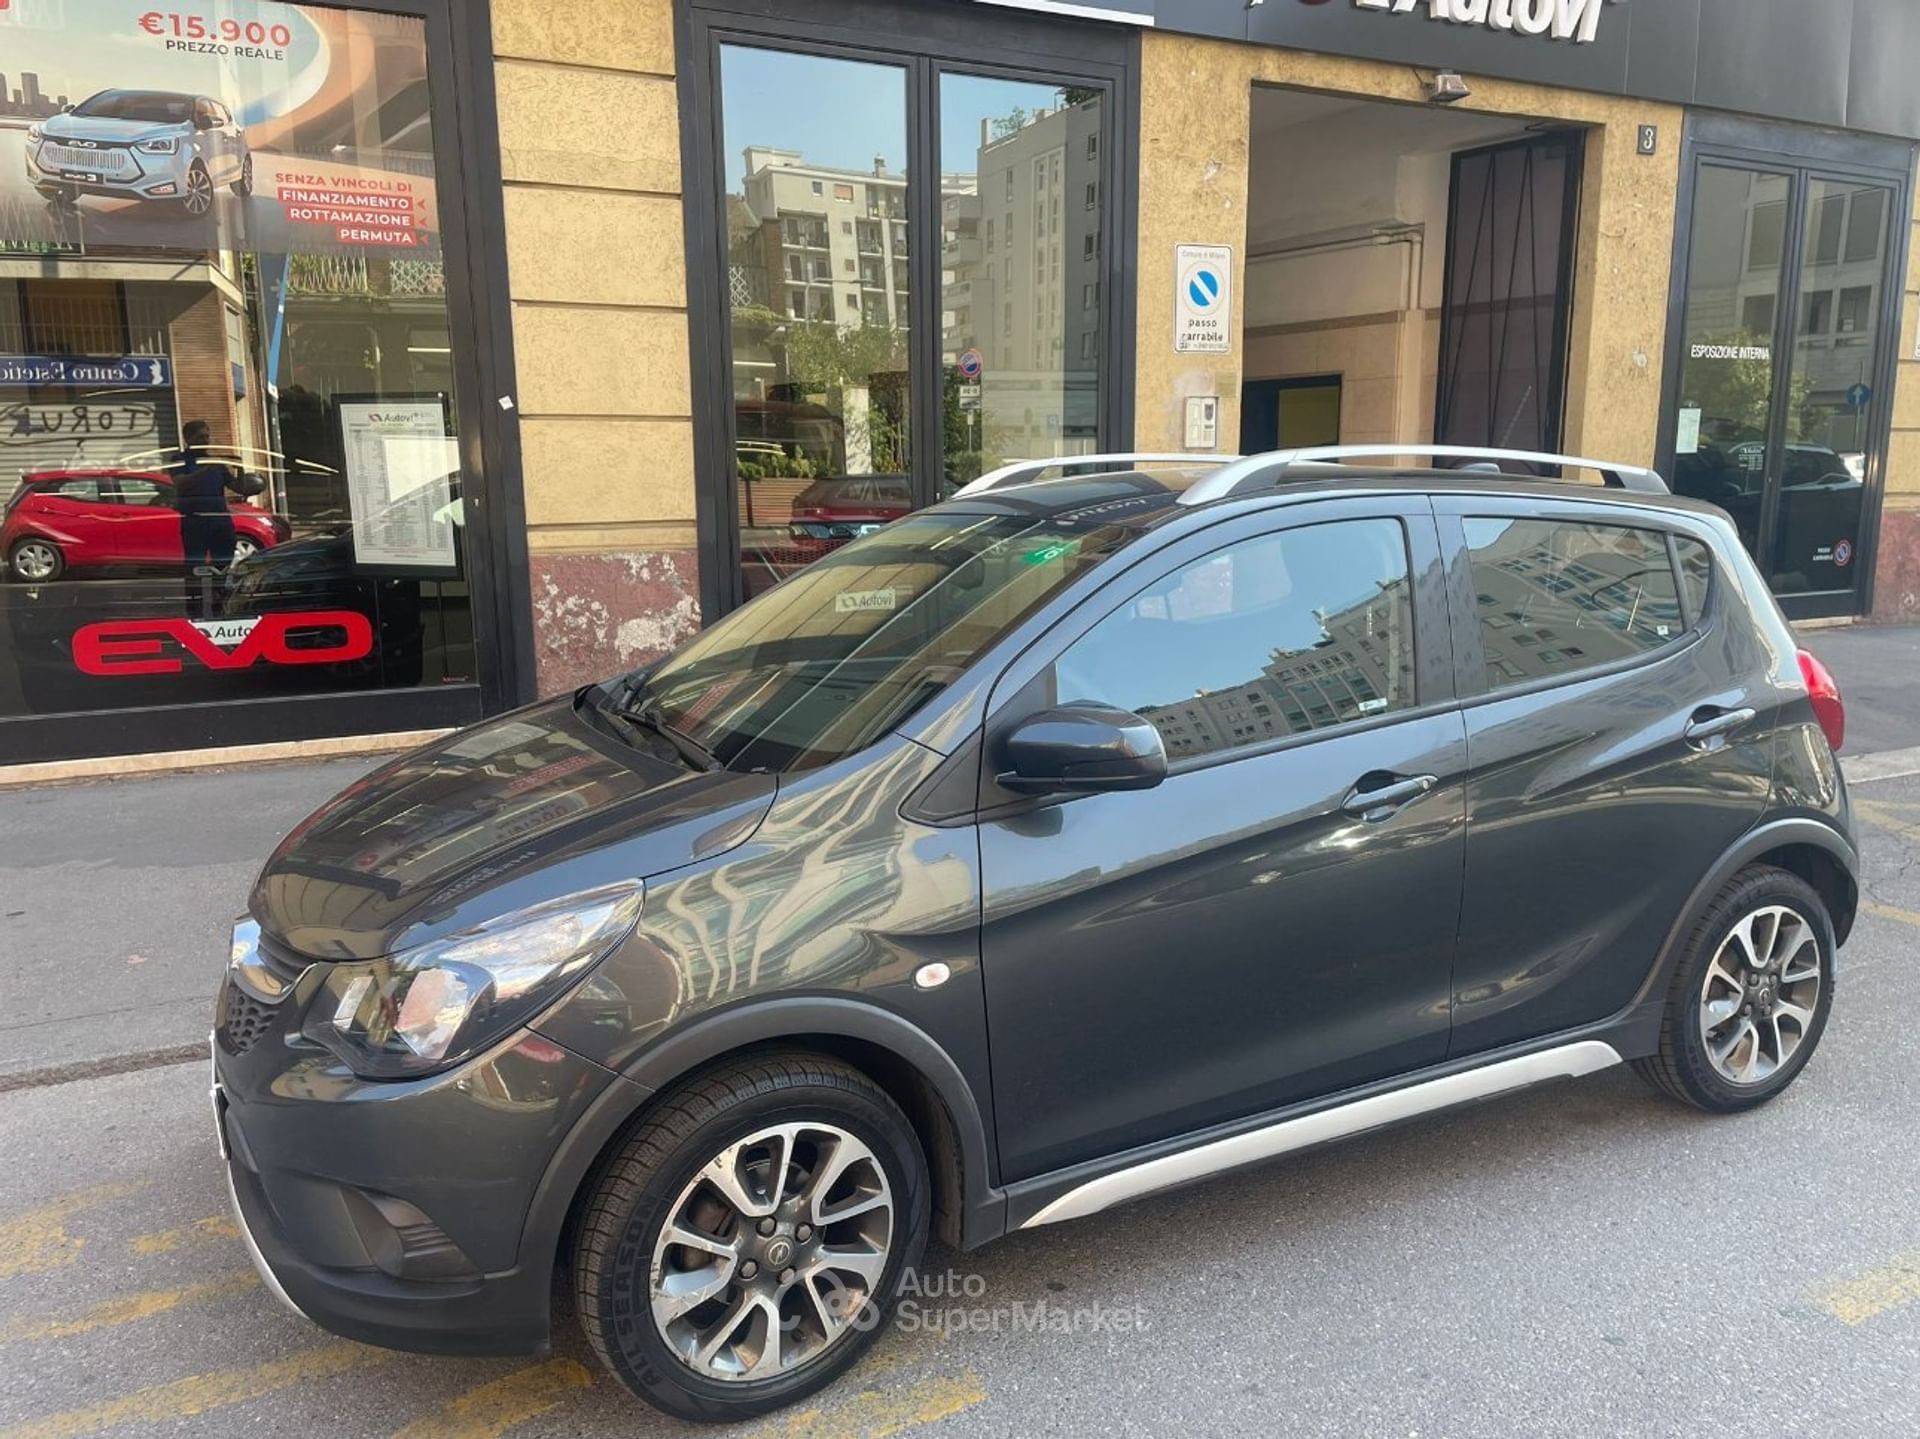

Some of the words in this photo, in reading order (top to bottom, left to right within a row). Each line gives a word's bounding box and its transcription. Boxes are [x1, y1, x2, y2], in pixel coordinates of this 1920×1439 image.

[138, 12, 291, 47] €15.900
[166, 40, 228, 55] PREZZO
[234, 46, 284, 61] REALE
[1643, 127, 1654, 149] 3
[275, 173, 326, 186] SENZA
[330, 177, 392, 191] VINCOLI
[397, 183, 412, 192] DI
[282, 190, 409, 209] FINANZIAMENTO
[290, 208, 411, 226] ROTTAMAZIONE
[340, 229, 413, 243] PERMUTA
[1188, 320, 1217, 328] passo
[1691, 344, 1738, 358] ESPOSIZIONE
[1740, 346, 1769, 359] INTERNA
[72, 611, 373, 675] EVO
[625, 1342, 664, 1386] ALL
